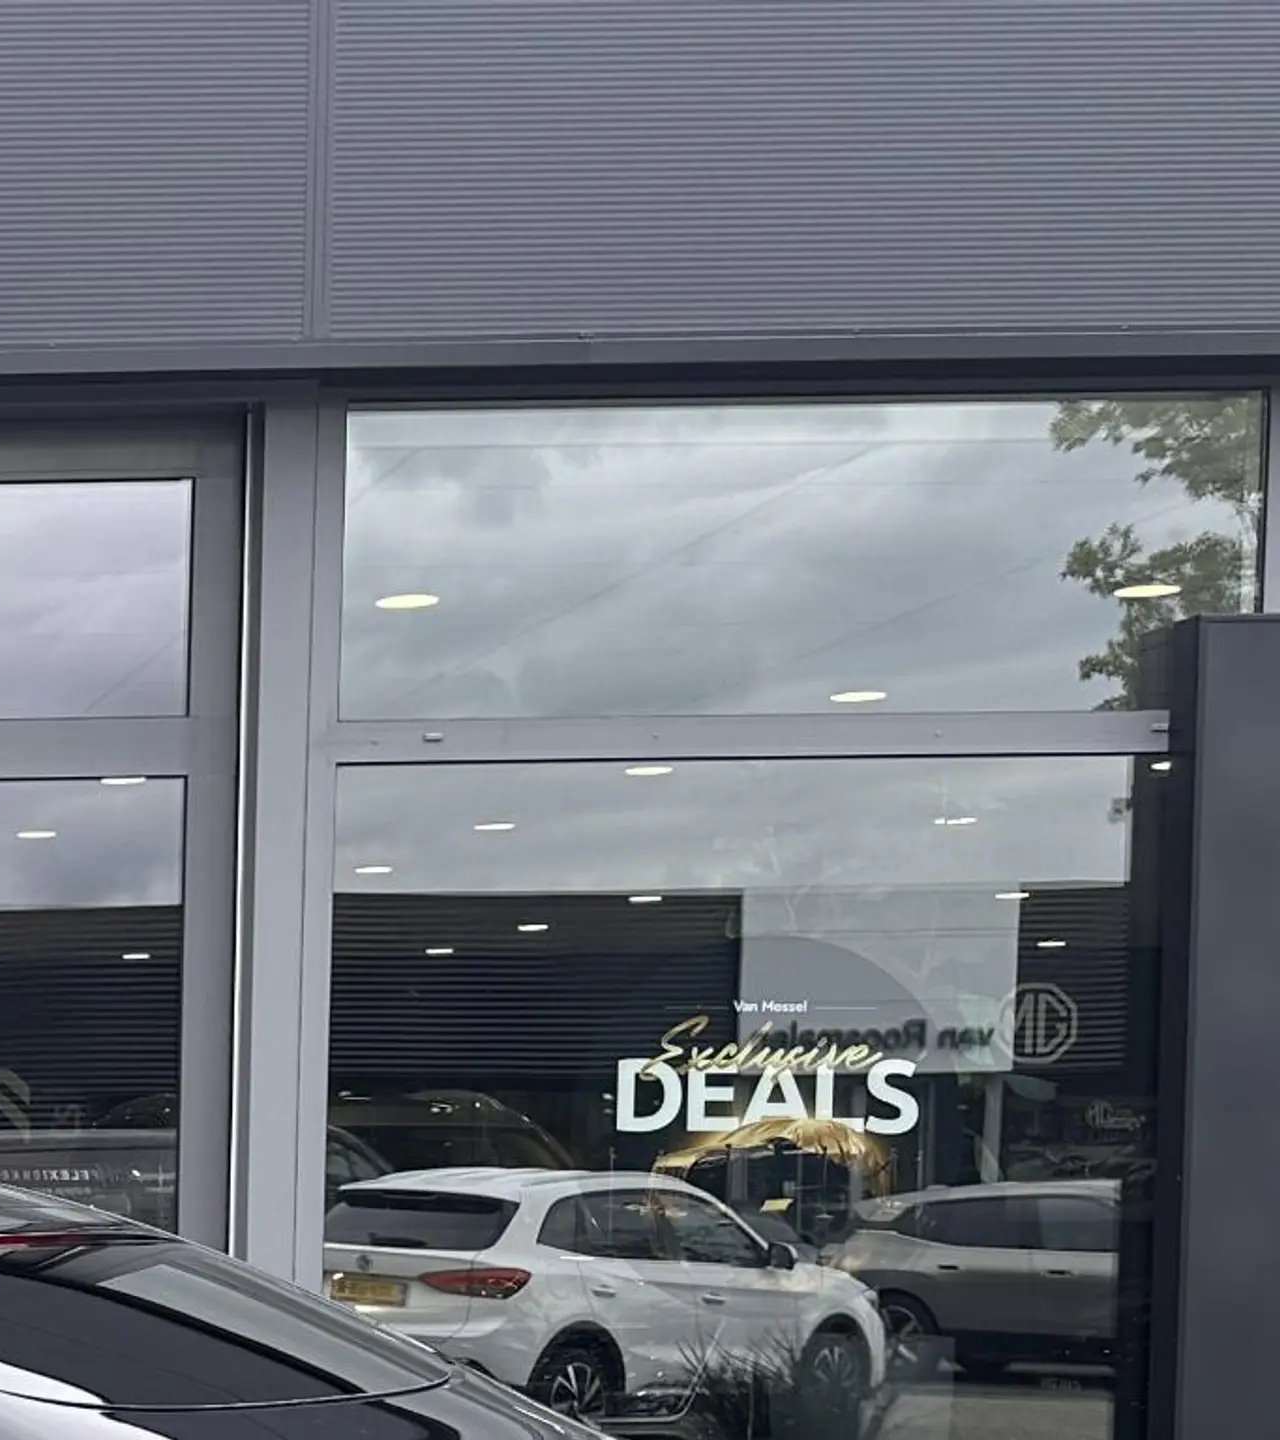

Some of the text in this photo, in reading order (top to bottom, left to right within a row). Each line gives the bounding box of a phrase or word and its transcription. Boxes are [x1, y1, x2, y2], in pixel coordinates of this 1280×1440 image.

[734, 1000, 808, 1014] Van Mossel
[640, 1015, 883, 1084] Exclusive
[615, 1058, 920, 1135] DEALS
